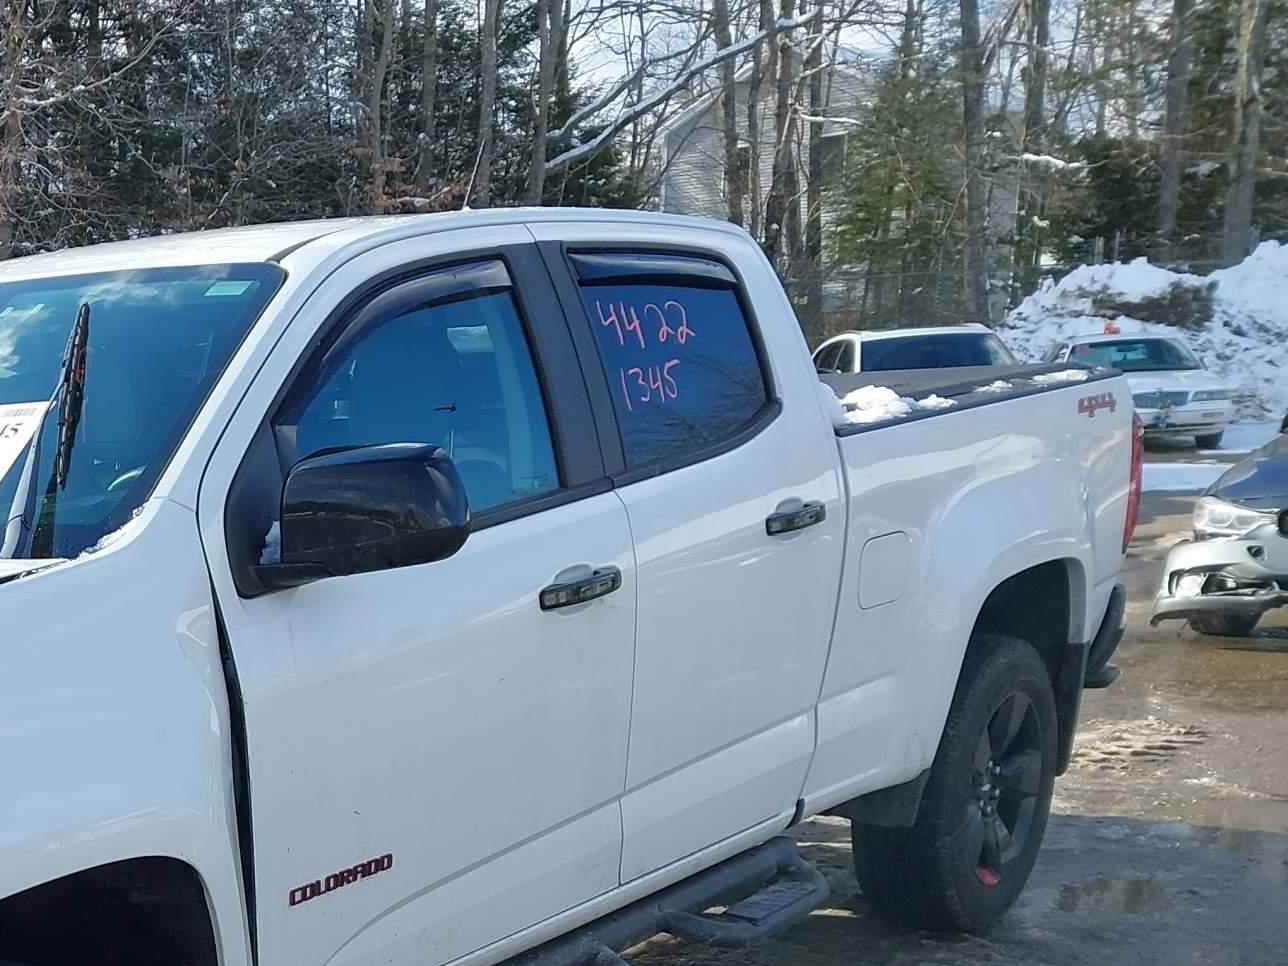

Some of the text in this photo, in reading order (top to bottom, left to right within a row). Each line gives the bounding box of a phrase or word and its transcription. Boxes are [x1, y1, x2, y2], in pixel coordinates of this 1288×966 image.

[596, 300, 696, 350] 4422
[620, 359, 681, 411] 1345
[289, 853, 393, 906] COLORADO
